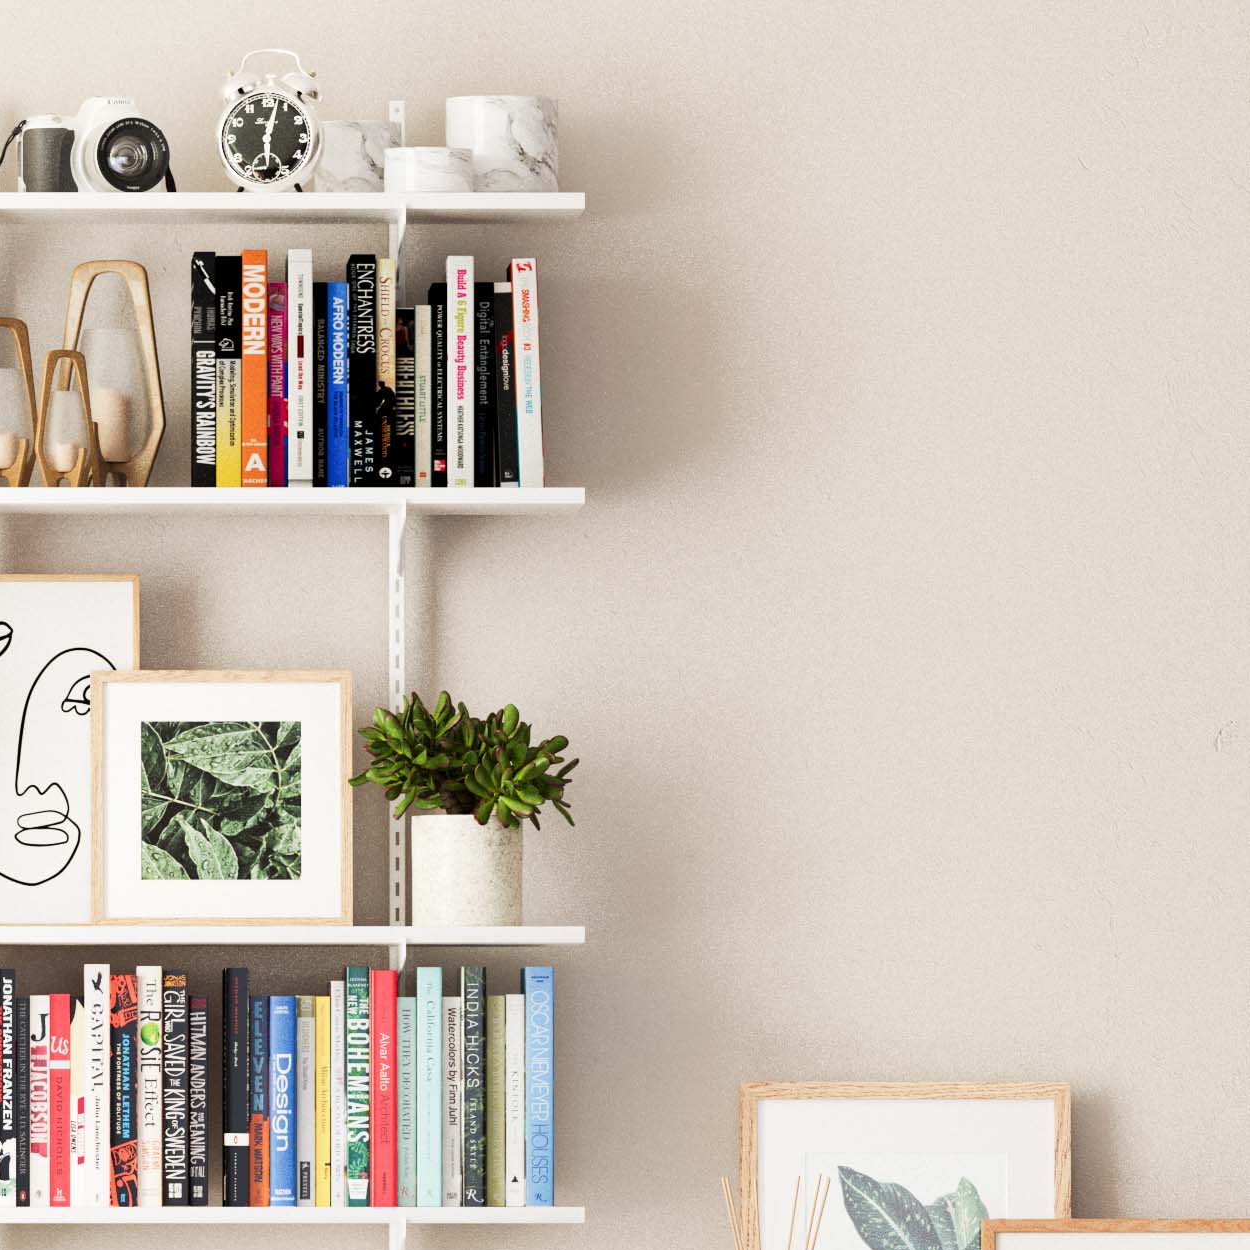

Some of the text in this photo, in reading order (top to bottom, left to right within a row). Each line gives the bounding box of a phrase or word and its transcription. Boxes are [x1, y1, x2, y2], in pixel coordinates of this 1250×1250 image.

[232, 118, 244, 127] 10
[245, 104, 254, 114] 11
[262, 99, 274, 108] 12
[282, 102, 288, 112] 1
[294, 116, 303, 125] 2
[228, 134, 236, 144] 9
[293, 150, 302, 159] 4
[299, 134, 308, 143] 3
[457, 269, 467, 290] Build
[243, 264, 265, 355] MODERN
[356, 263, 375, 353] ENCHANTRESS
[380, 277, 391, 374] SHIELD CROCUS
[455, 307, 467, 333] Figure
[477, 302, 490, 333] Digital
[271, 316, 283, 397] NEW WAYS WITH PAINT
[317, 319, 325, 404] BALANCED MINISTRY
[333, 297, 344, 384] AFRO MODERN
[455, 335, 466, 363] Beauty
[456, 365, 467, 400] Business
[477, 339, 490, 405] Entanglement
[196, 351, 215, 465] GRAVITY'S RAINBOW
[245, 453, 265, 472] A
[354, 421, 362, 483] MAXWELL
[365, 430, 373, 473] JAMES
[348, 995, 357, 1015] NEW
[360, 998, 368, 1014] THE
[2, 977, 13, 1130] JONATHAN FRANZEN
[190, 1011, 206, 1108] HITMAN ANDERS
[466, 983, 479, 1088] INDIA HICKS
[122, 1034, 130, 1138] JONATHAN LETHEM
[348, 1019, 369, 1143] BOHEMIANS
[379, 1033, 390, 1144] Alvar Aalto Architect
[446, 1008, 458, 1126] Watercolors by Finn Juhl
[530, 990, 549, 1184] OSCAR NIEMEYER HOUSES
[116, 1091, 121, 1100] OF
[273, 1053, 291, 1152] Design
